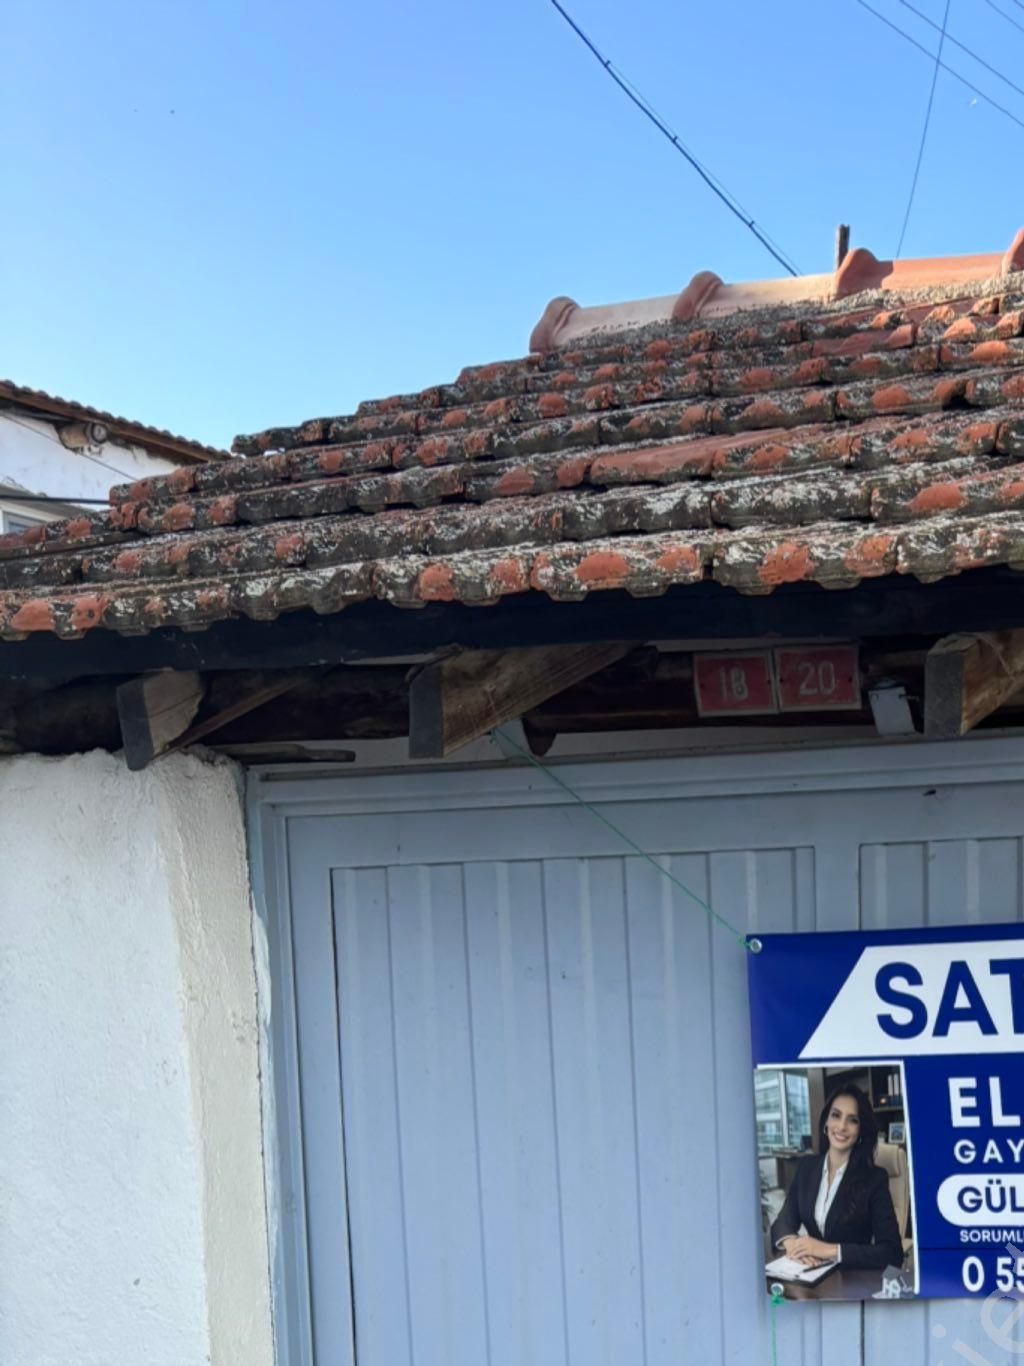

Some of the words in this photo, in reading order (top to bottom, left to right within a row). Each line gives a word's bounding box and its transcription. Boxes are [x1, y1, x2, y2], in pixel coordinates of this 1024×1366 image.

[718, 666, 749, 701] 18
[799, 660, 836, 696] 20
[962, 1256, 985, 1292] 0
